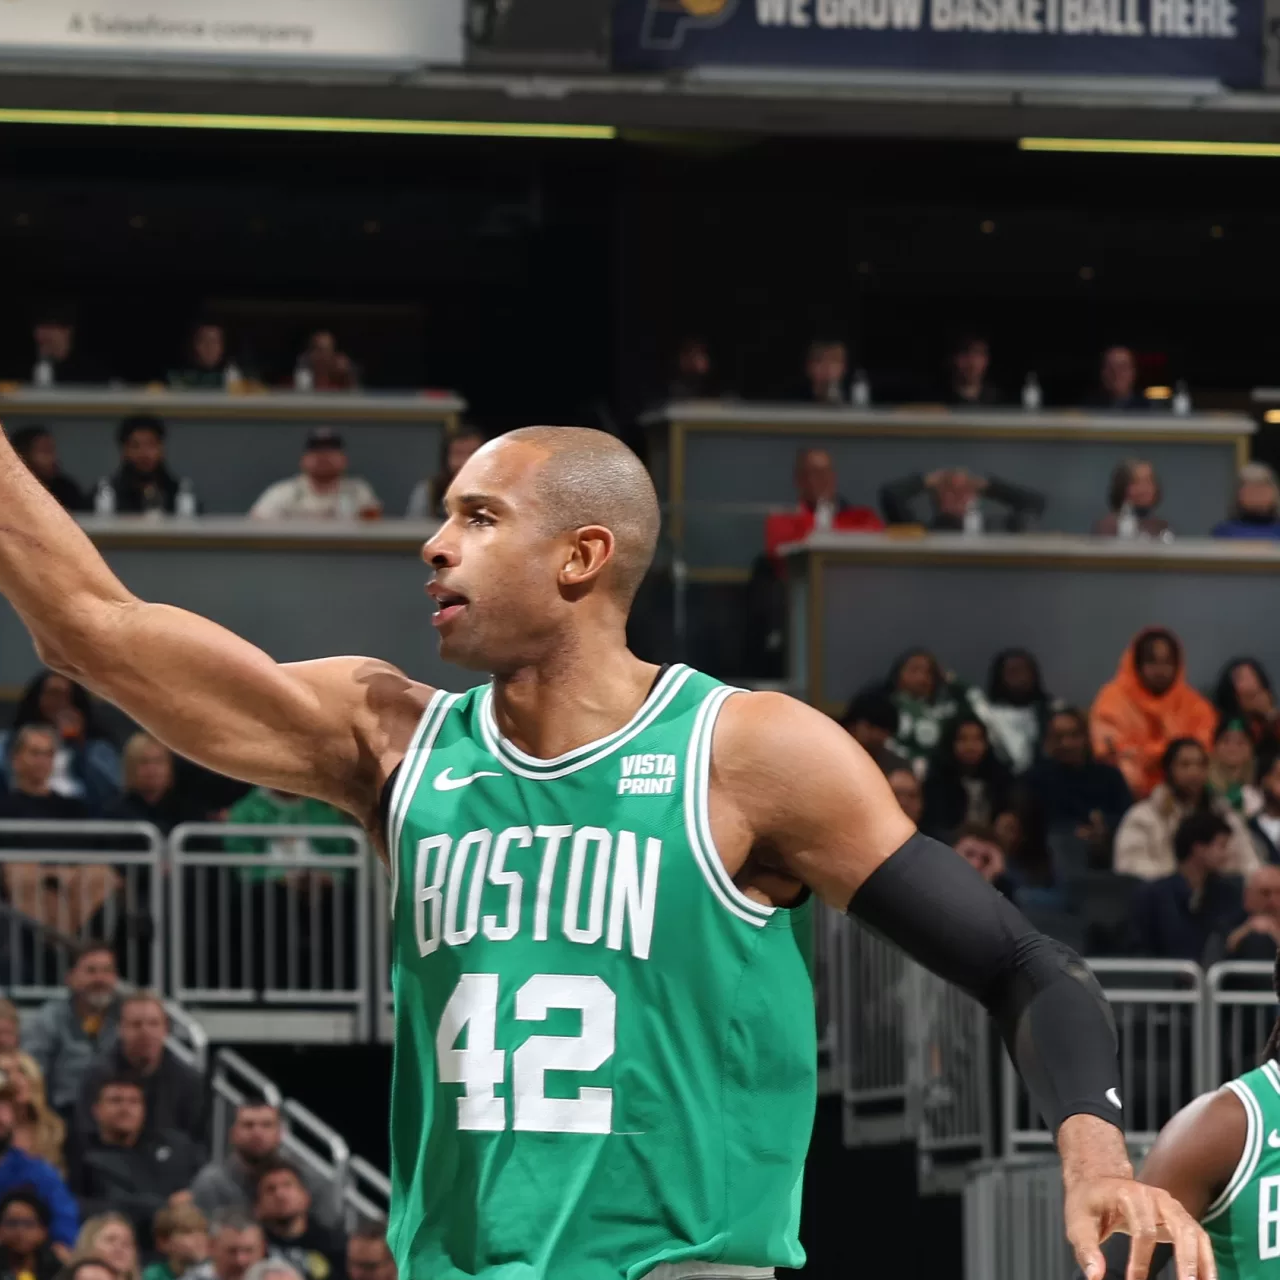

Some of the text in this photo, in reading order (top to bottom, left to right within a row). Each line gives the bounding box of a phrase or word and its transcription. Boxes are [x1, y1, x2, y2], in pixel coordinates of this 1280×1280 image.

[212, 20, 314, 46] company
[930, 0, 1144, 37] BASKETBALL
[1149, 0, 1237, 38] HERE
[621, 753, 676, 777] VISTA
[617, 776, 676, 795] PRINT
[415, 825, 662, 960] BOSTON
[435, 973, 617, 1134] 42
